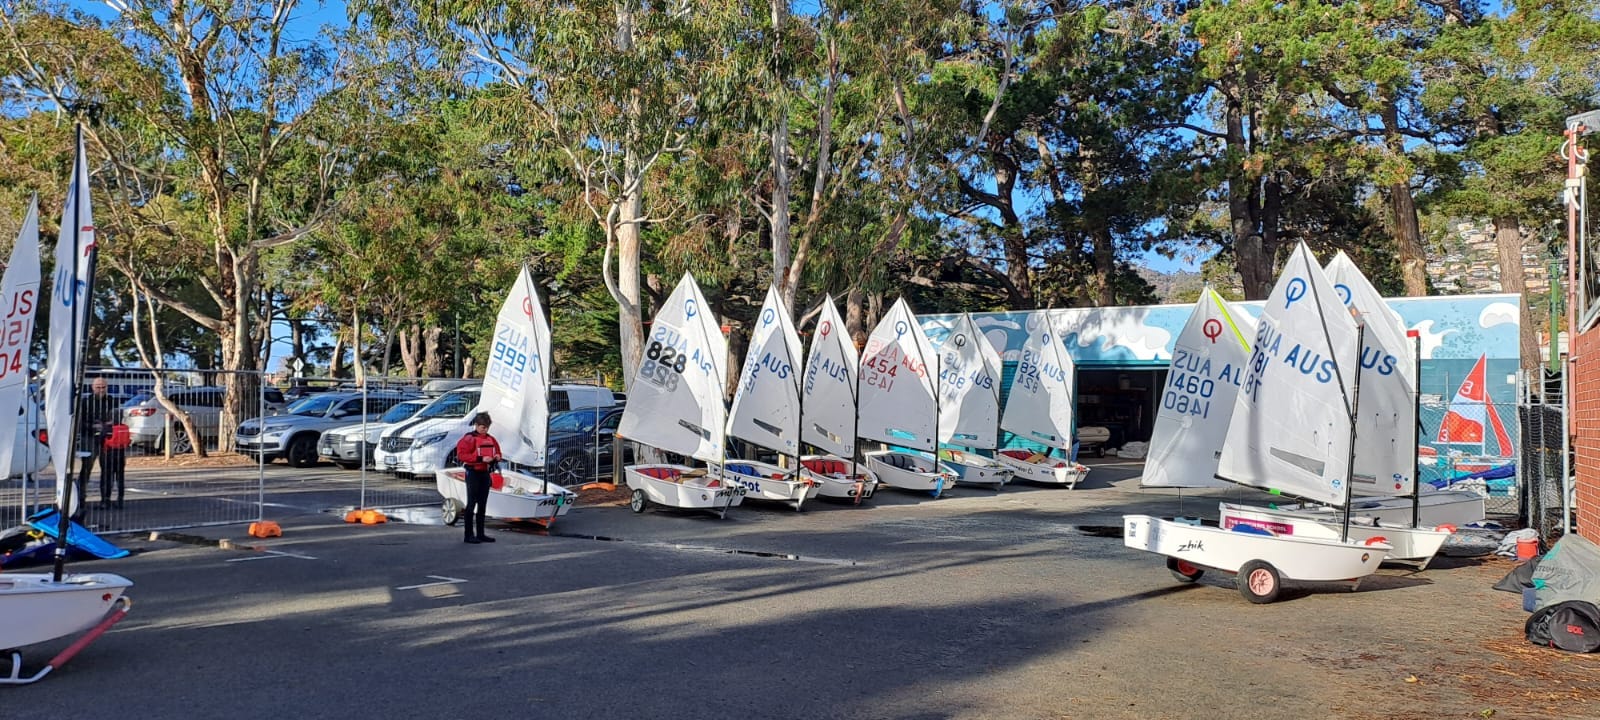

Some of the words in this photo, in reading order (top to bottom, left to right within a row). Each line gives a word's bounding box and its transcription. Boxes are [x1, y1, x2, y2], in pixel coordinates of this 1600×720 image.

[493, 341, 527, 373] 999
[647, 341, 687, 374] 828
[691, 347, 712, 376] AUS
[762, 352, 791, 379] AUS
[822, 357, 848, 382] AUS
[862, 353, 898, 378] 1454
[902, 355, 927, 378] AUS
[1249, 344, 1270, 378] 781
[1284, 343, 1336, 383] AUS
[1360, 346, 1397, 375] US
[970, 369, 993, 389] AUS
[1042, 362, 1066, 382] AUS
[1168, 369, 1215, 398] 1460
[1461, 380, 1474, 395] 3
[539, 498, 574, 506] MUTO
[1177, 540, 1205, 552] zhik
